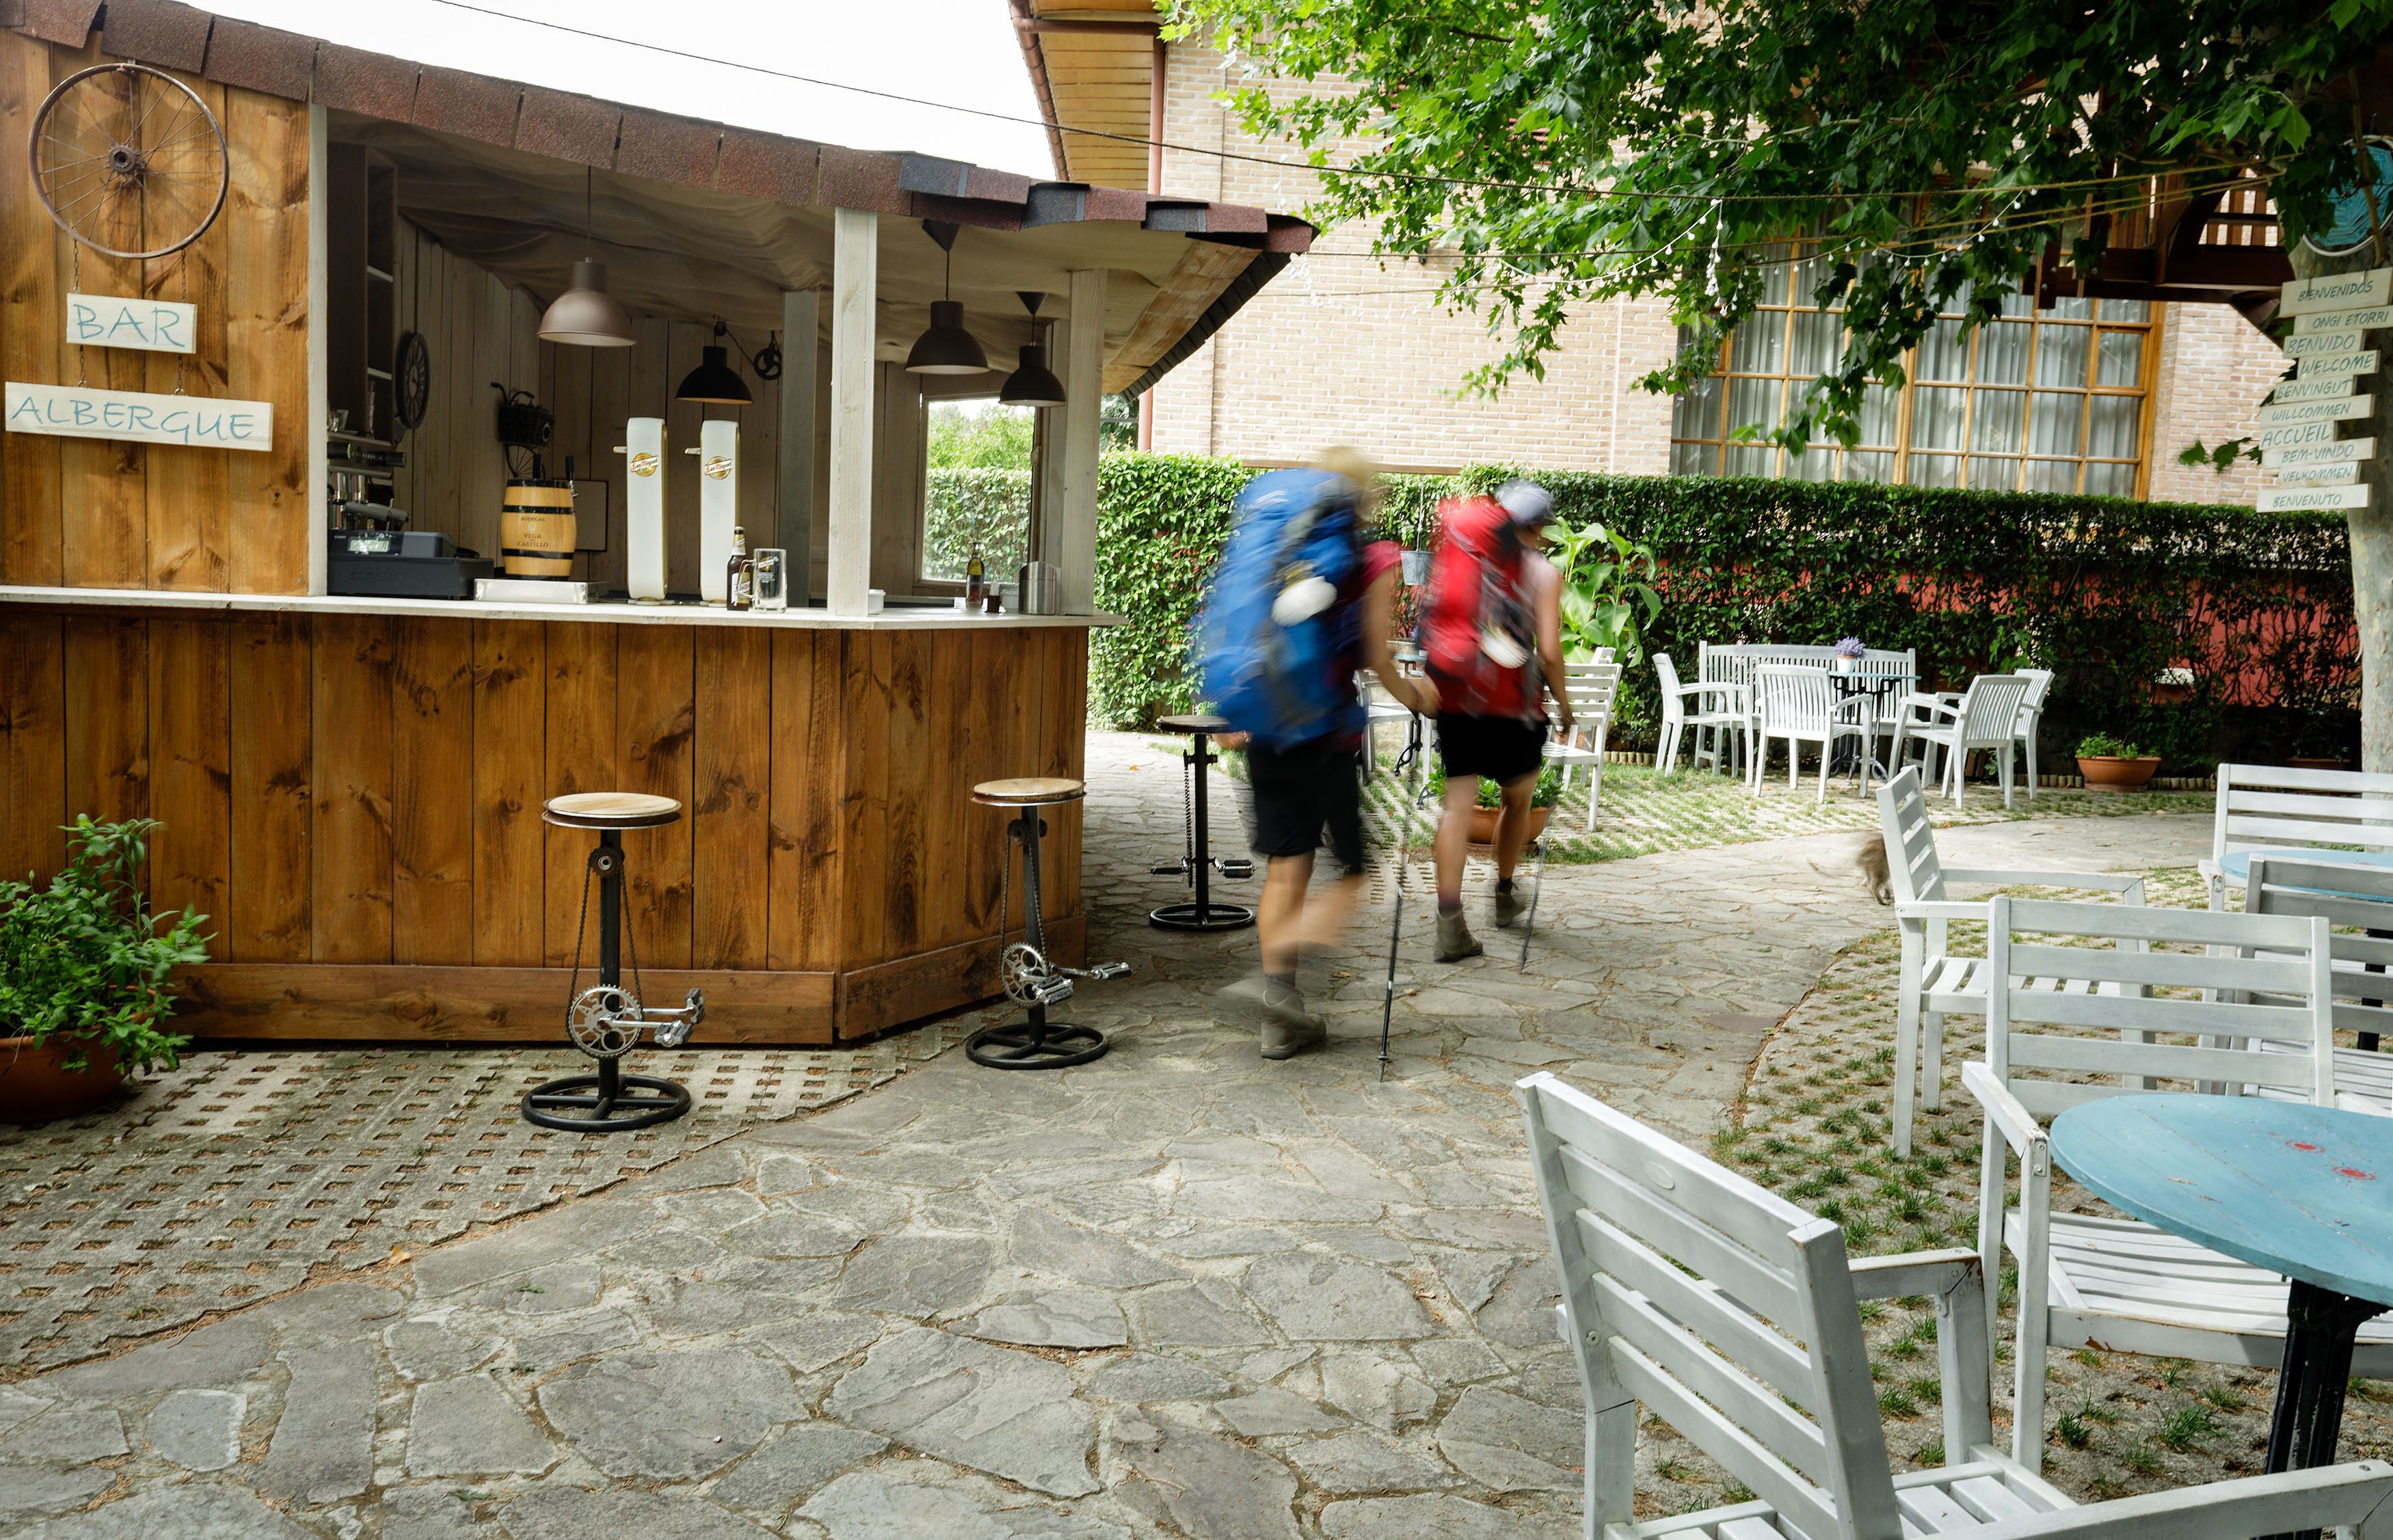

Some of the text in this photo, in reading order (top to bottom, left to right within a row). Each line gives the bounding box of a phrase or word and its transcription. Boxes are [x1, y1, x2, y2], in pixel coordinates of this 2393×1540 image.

[2298, 280, 2373, 302] BIENVENIDOS
[72, 303, 185, 348] BAR
[2312, 310, 2389, 329] ONGI ETORRI
[2286, 334, 2355, 354] BENVIDO
[2301, 353, 2375, 375] WELCOME
[2276, 379, 2353, 400] BENVINGUT
[10, 395, 255, 445] ALBERGUE
[2271, 401, 2352, 422] WILLCOMMEN
[2261, 424, 2332, 448] ACCUEIL
[2282, 444, 2355, 463] BEM-VINDO
[2282, 465, 2353, 483] VELKOMMEN
[2273, 493, 2342, 508] BENVENUTO
